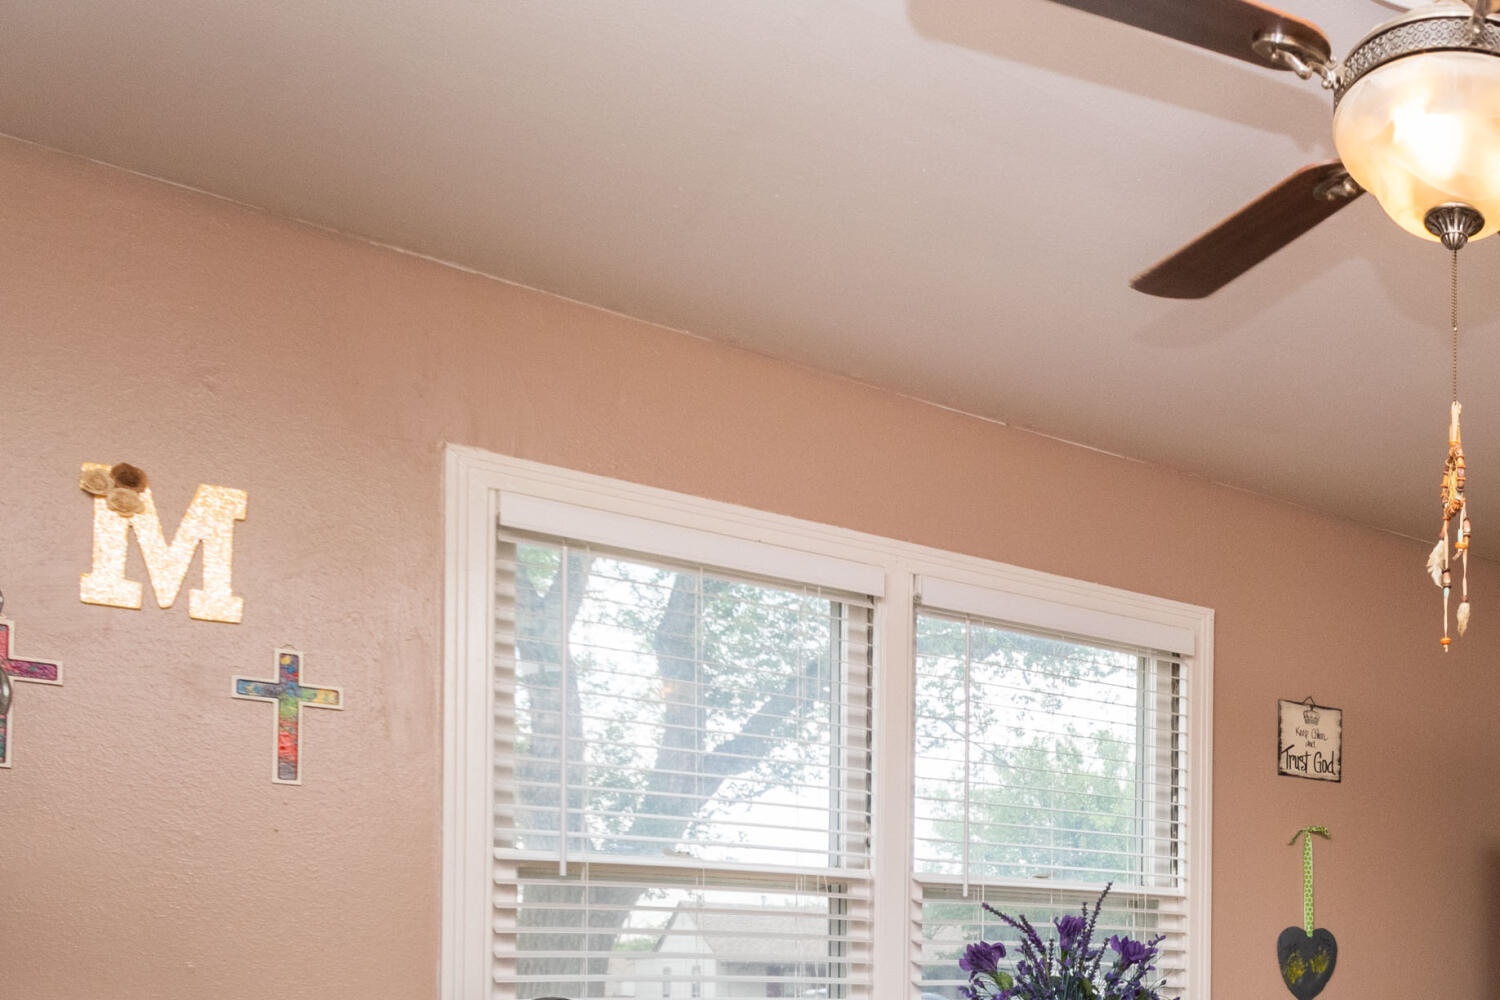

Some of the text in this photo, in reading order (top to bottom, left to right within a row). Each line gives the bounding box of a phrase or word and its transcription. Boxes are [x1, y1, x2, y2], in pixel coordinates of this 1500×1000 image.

[80, 462, 248, 625] M
[1281, 744, 1336, 775] Trust God
